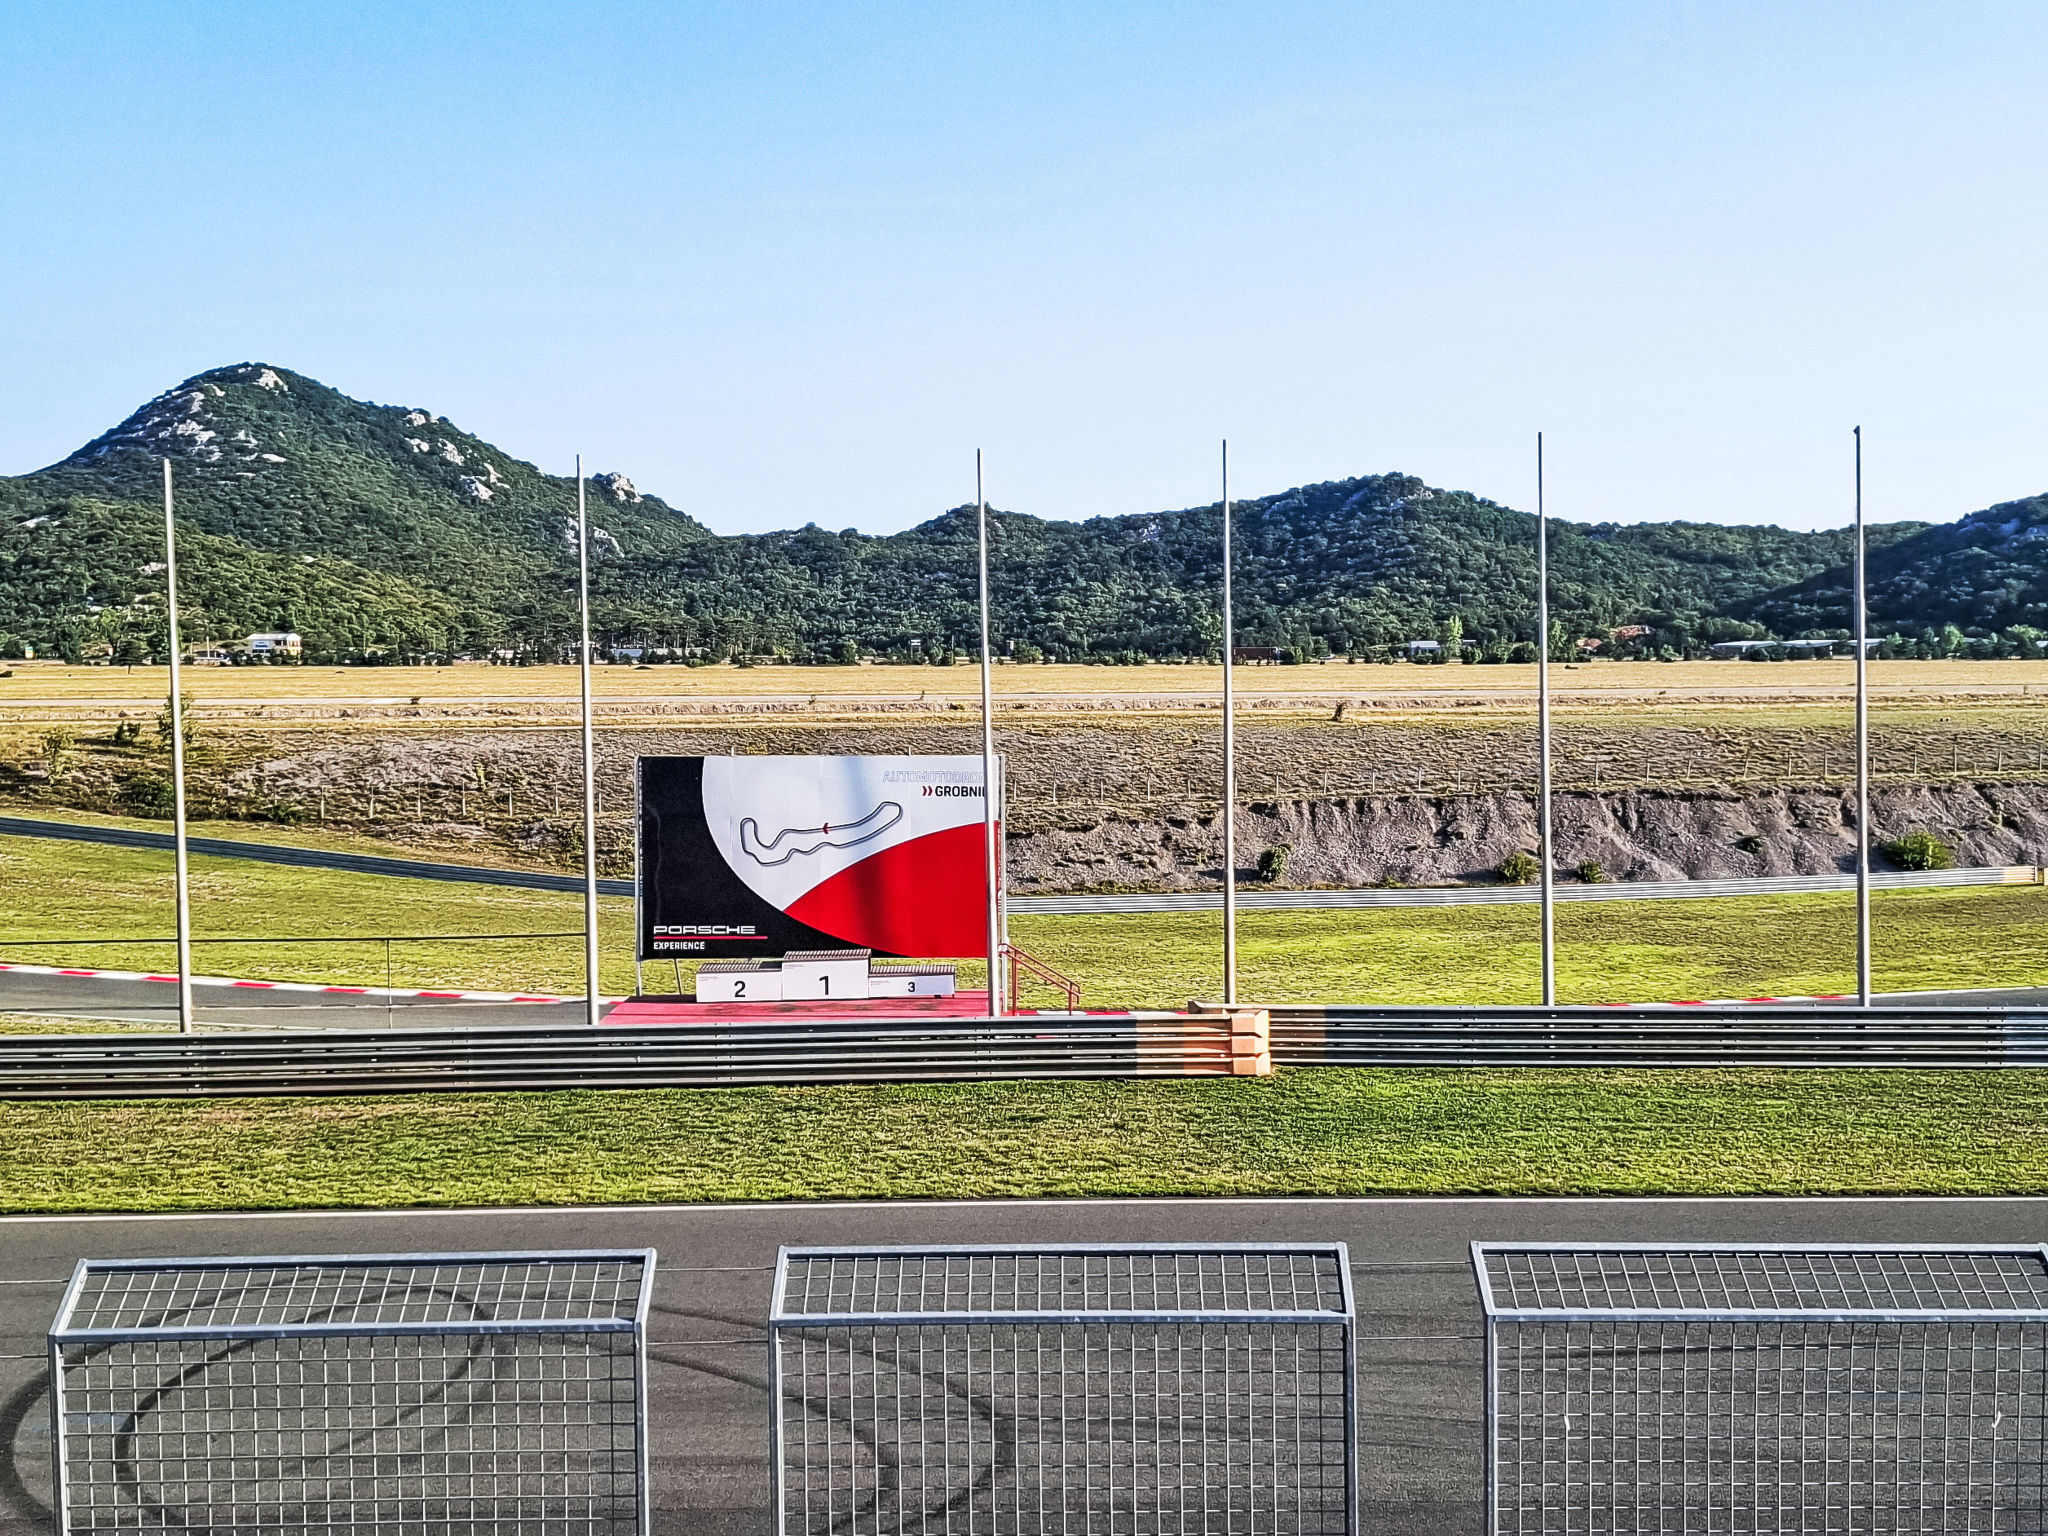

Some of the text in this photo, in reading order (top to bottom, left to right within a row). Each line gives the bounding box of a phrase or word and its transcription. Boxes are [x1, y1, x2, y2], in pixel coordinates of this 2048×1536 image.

[935, 785, 985, 797] GROBNI
[653, 925, 756, 935] PORSCHE
[653, 941, 706, 950] EXPERIENCE
[733, 980, 746, 998] 2
[819, 975, 829, 996] 1
[907, 981, 916, 993] 3
